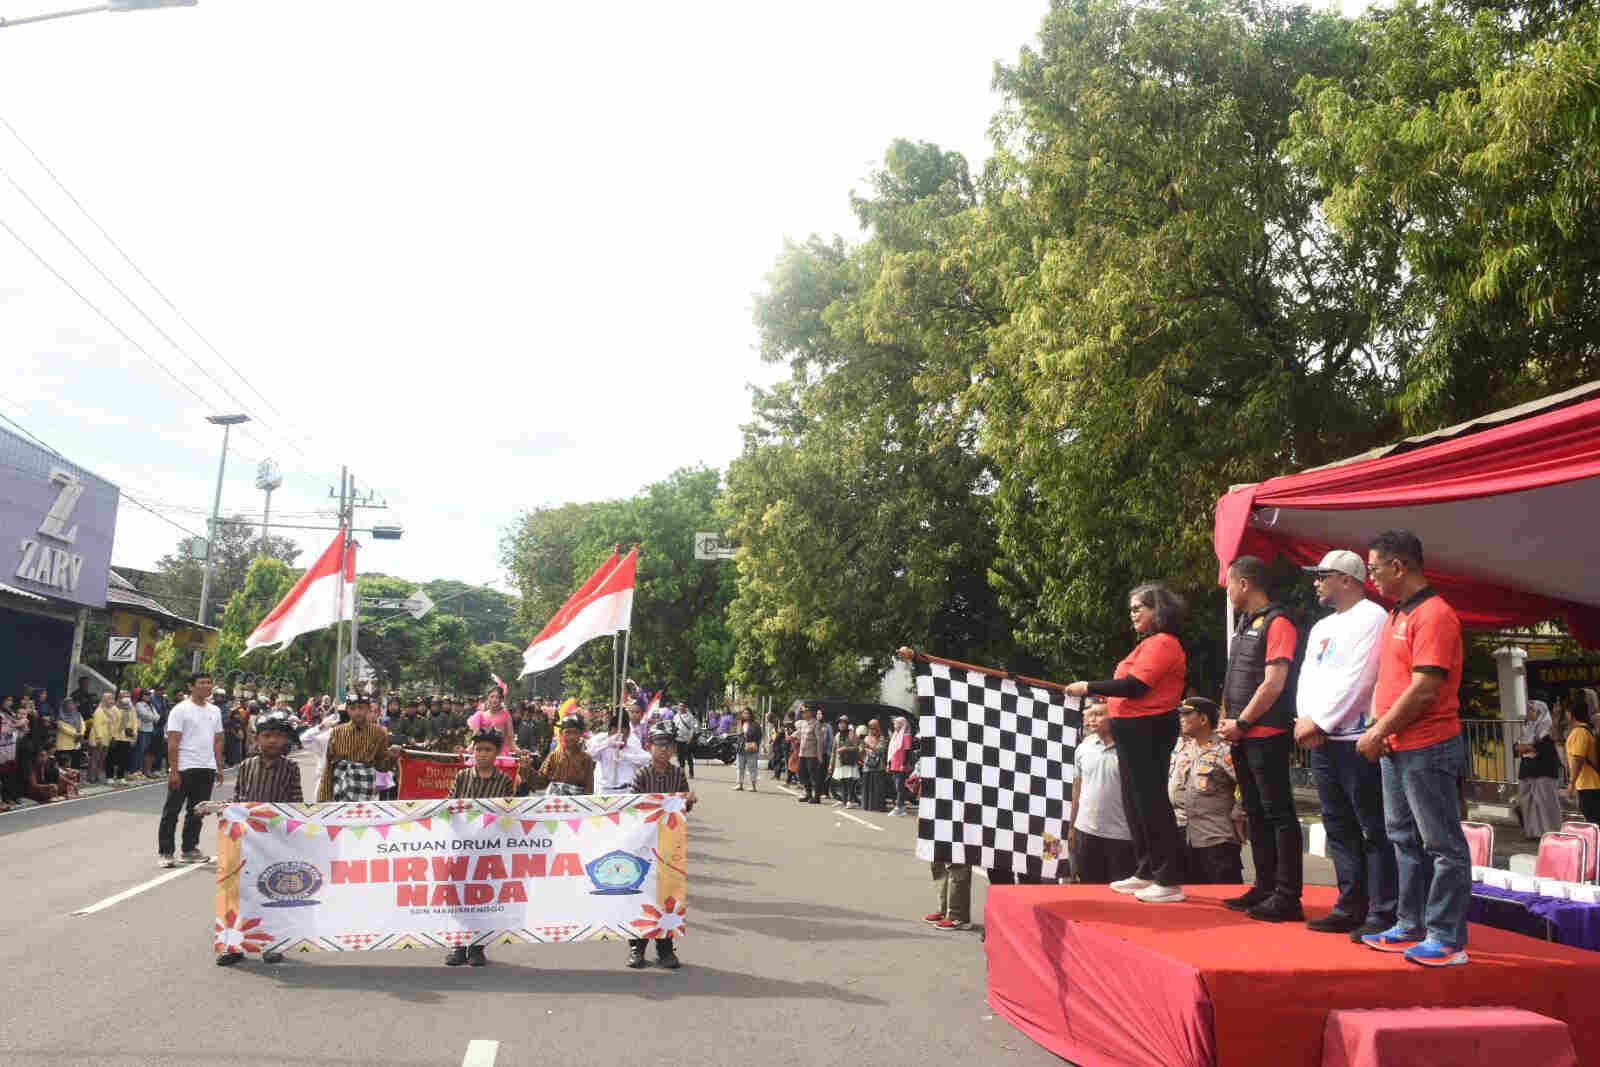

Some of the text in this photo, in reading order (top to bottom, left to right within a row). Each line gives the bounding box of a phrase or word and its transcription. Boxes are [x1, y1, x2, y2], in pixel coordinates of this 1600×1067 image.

[38, 471, 87, 544] Z
[15, 539, 83, 592] ZARY
[376, 837, 553, 854] SATUAN DRUM BAND
[330, 852, 585, 885] NIRWANA
[396, 880, 529, 907] NADA
